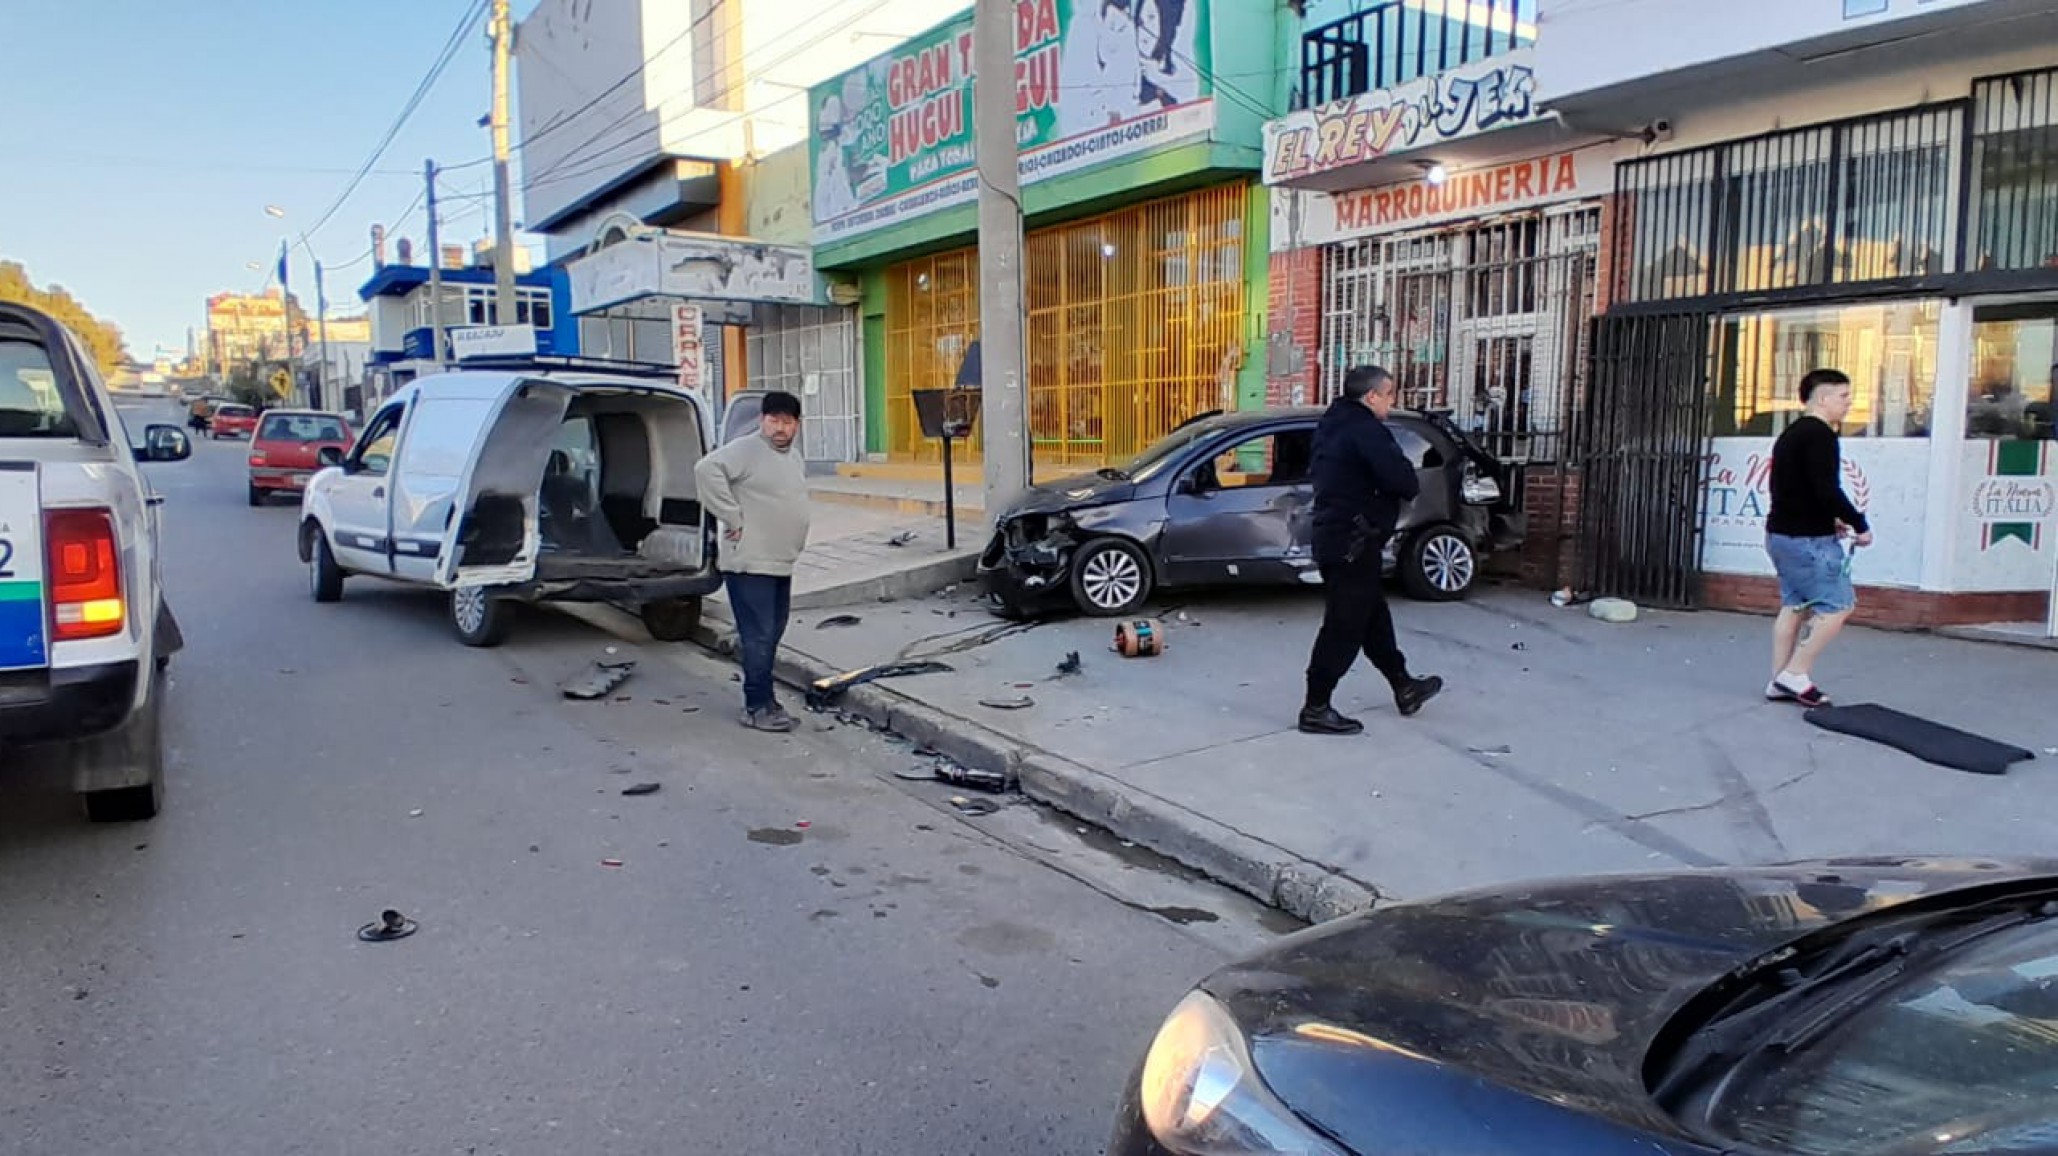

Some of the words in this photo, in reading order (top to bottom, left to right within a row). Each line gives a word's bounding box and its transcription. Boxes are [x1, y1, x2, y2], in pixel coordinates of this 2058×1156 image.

[889, 42, 951, 108] GRAN
[889, 88, 963, 166] HUGUI
[1272, 126, 1310, 177] EL
[1315, 99, 1402, 167] REY
[1334, 153, 1577, 231] MARROQUINERIA
[1986, 499, 2042, 514] ITALIA
